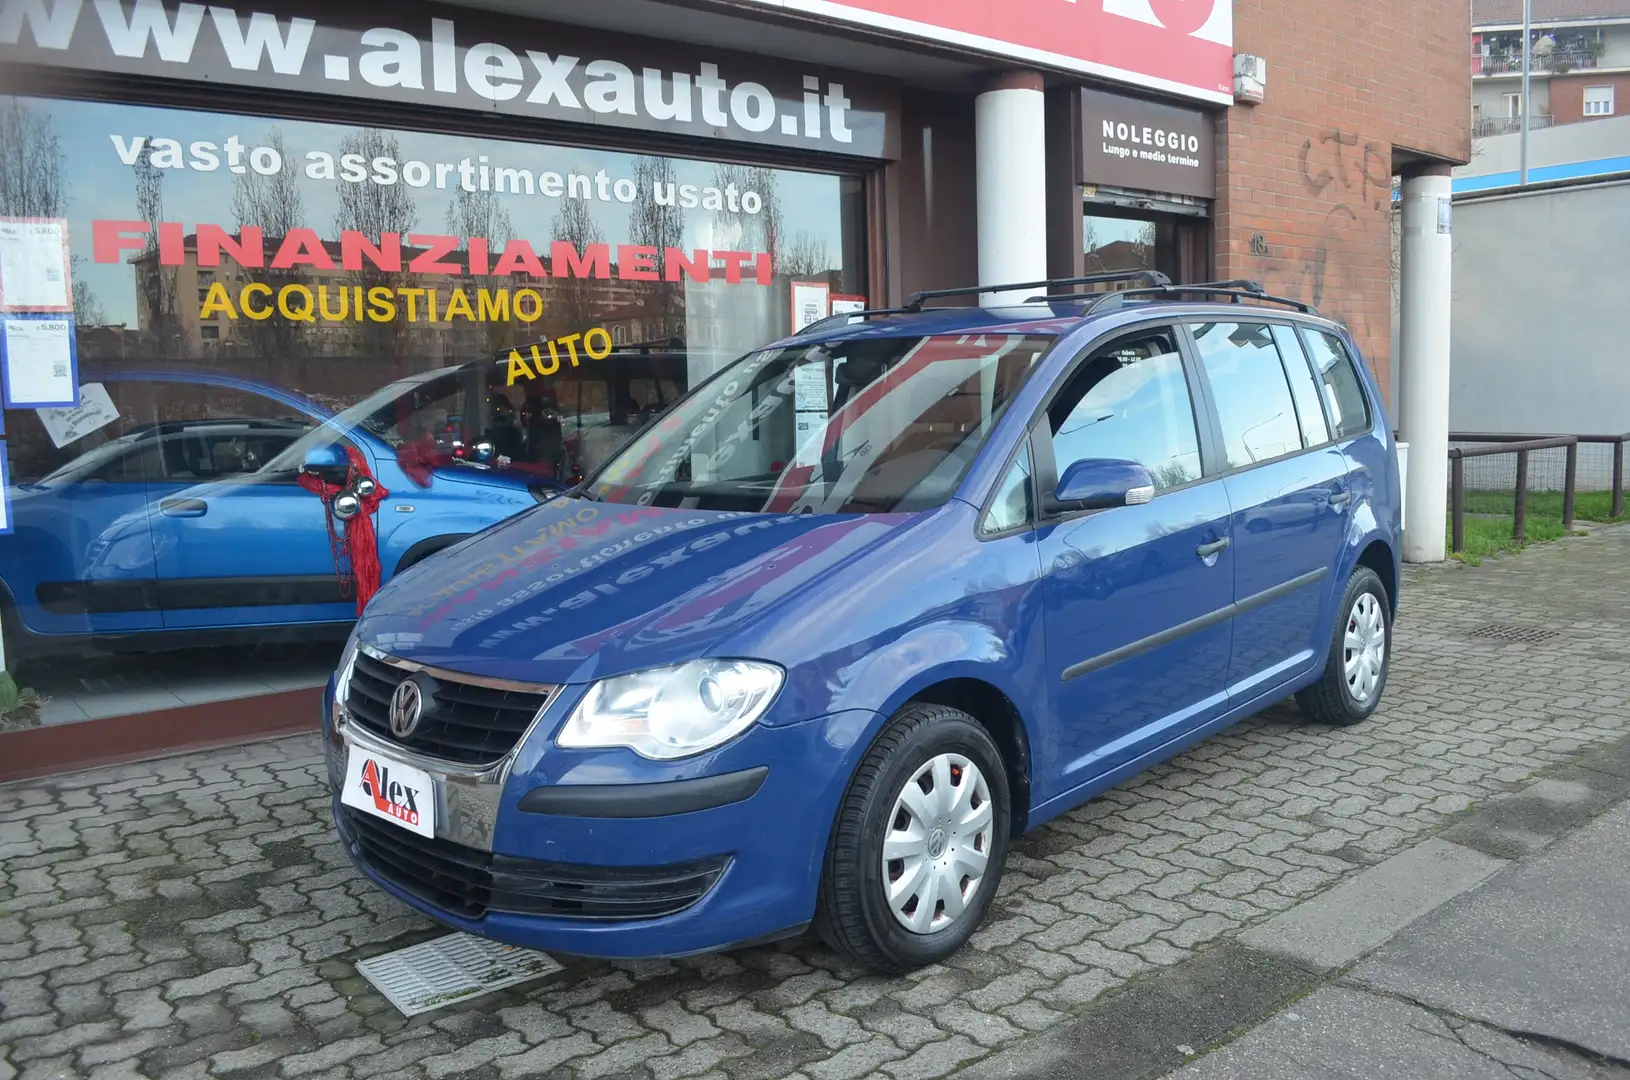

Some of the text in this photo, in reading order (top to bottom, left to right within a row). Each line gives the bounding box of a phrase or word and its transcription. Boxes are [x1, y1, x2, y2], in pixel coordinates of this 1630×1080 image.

[0, 0, 852, 143] www.alexauto.it
[1102, 120, 1198, 152] NOLEGGIO
[1103, 142, 1200, 167] Lungo e medio termine
[109, 134, 763, 214] vasto assortimento usato
[92, 219, 772, 286] FINANZIAMENTI
[200, 282, 543, 323] ACQUISTIAMO
[506, 328, 612, 386] AUTO
[359, 758, 420, 812] Alex
[387, 803, 418, 824] AUTO
